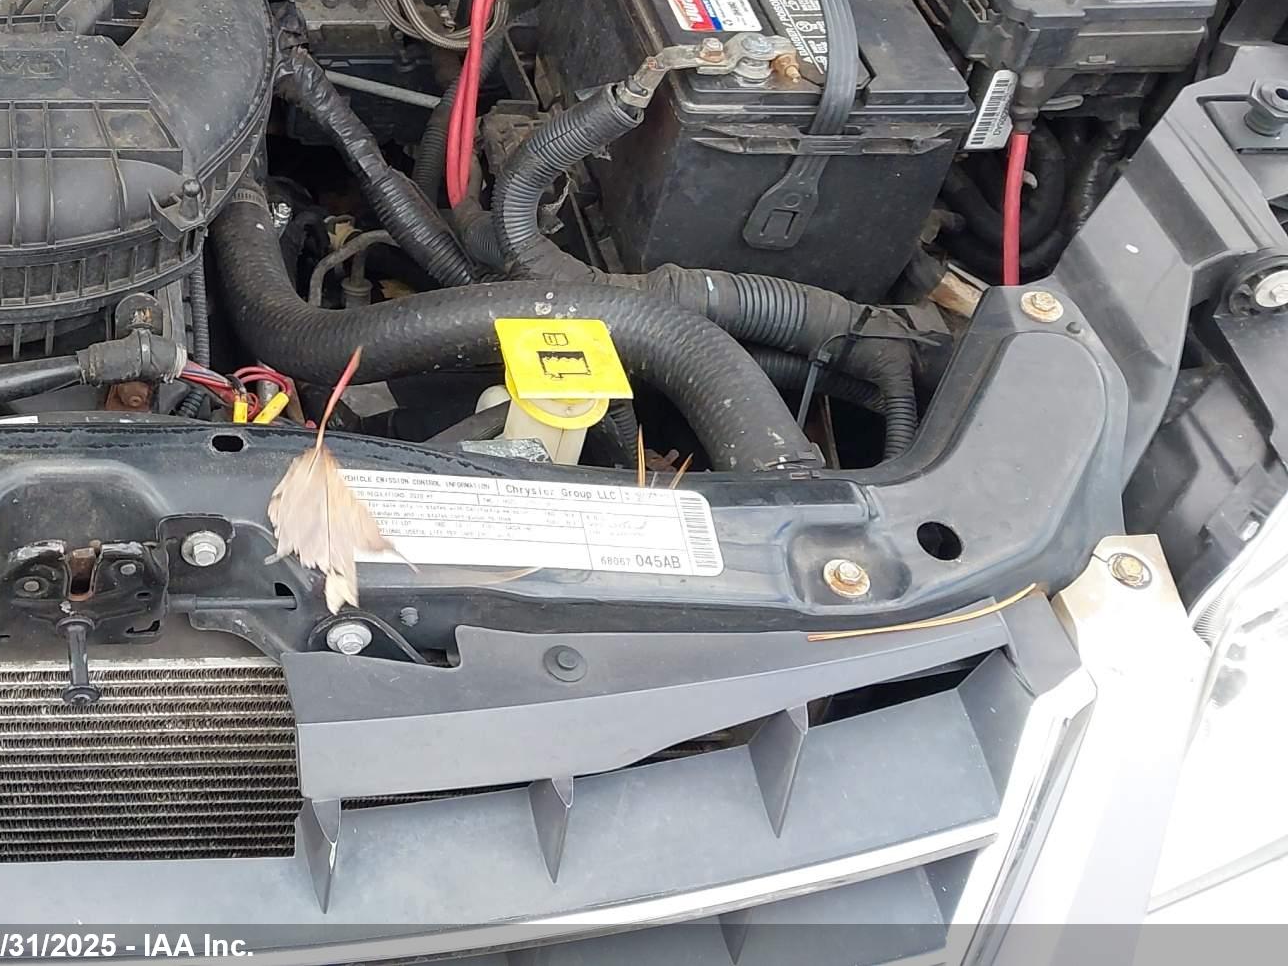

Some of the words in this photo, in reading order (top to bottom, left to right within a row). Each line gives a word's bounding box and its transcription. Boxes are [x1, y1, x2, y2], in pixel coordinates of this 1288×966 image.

[784, 26, 809, 56] DANGER
[343, 474, 372, 483] VEHICLE
[375, 476, 409, 485] EMISSION
[411, 478, 441, 487] CONTROL
[445, 480, 490, 490] INFORMATION
[505, 484, 555, 498] Chrysler
[561, 488, 592, 500] Group
[596, 490, 617, 500] LLC
[636, 554, 681, 569] 045AB
